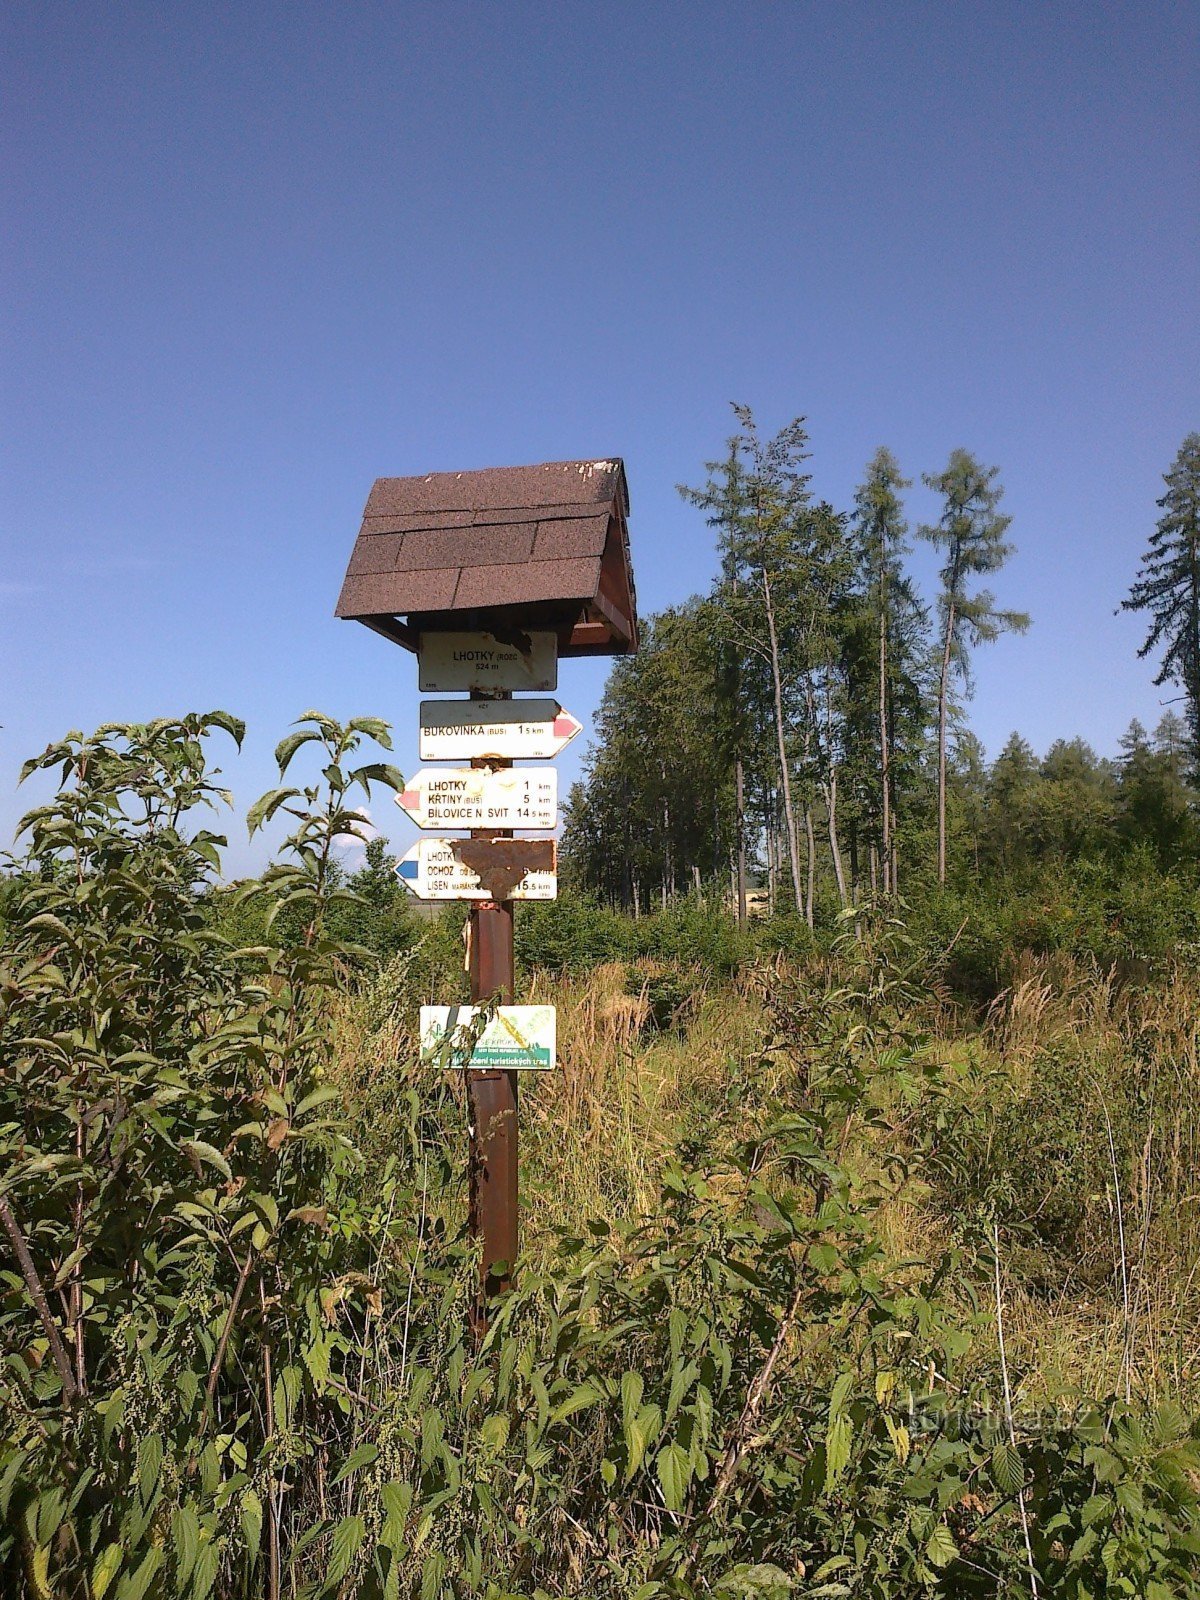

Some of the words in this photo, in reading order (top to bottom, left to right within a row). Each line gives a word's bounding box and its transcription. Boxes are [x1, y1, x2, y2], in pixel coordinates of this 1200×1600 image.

[453, 650, 494, 661] LHOTKY
[424, 725, 485, 737] BUKOVINKA
[486, 727, 507, 736] (BUS)
[531, 727, 544, 735] km
[428, 781, 467, 791] LHOTKY
[523, 780, 530, 790] 1
[428, 792, 462, 804] KŘTINY
[463, 796, 483, 805] (BUS)
[523, 794, 530, 804] 5
[427, 851, 455, 862] LHOTK
[427, 865, 454, 876] OCHOZ
[490, 1055, 532, 1067] turistických
